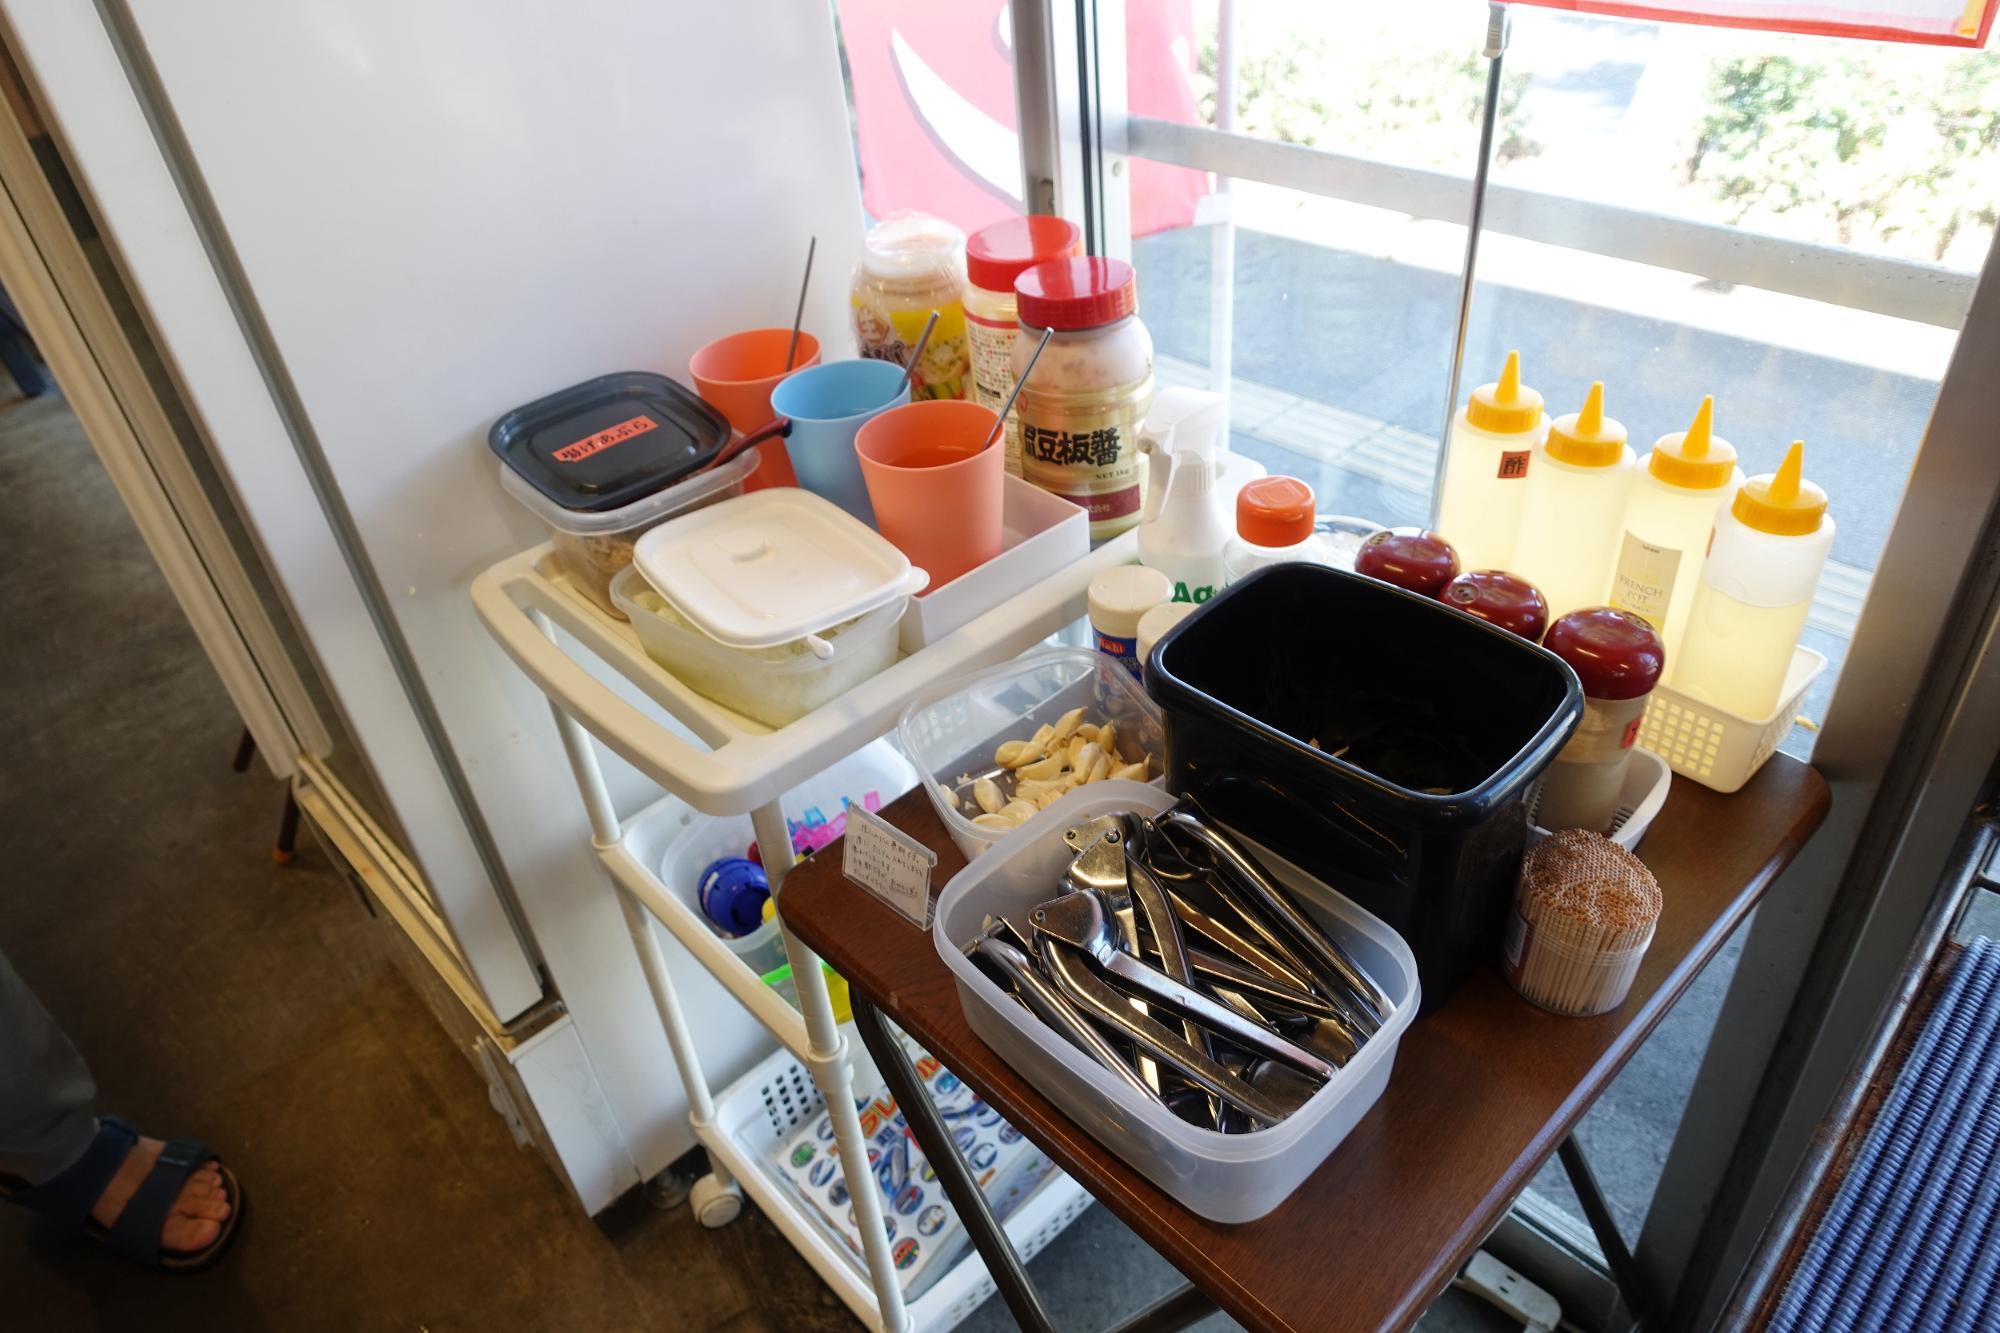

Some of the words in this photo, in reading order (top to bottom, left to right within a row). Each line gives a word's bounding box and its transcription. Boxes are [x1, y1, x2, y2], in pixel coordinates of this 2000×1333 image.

[1503, 455, 1526, 475] 酢
[1095, 472, 1114, 481] NET
[1619, 574, 1664, 598] FRENCH
[1627, 590, 1649, 604] POT
